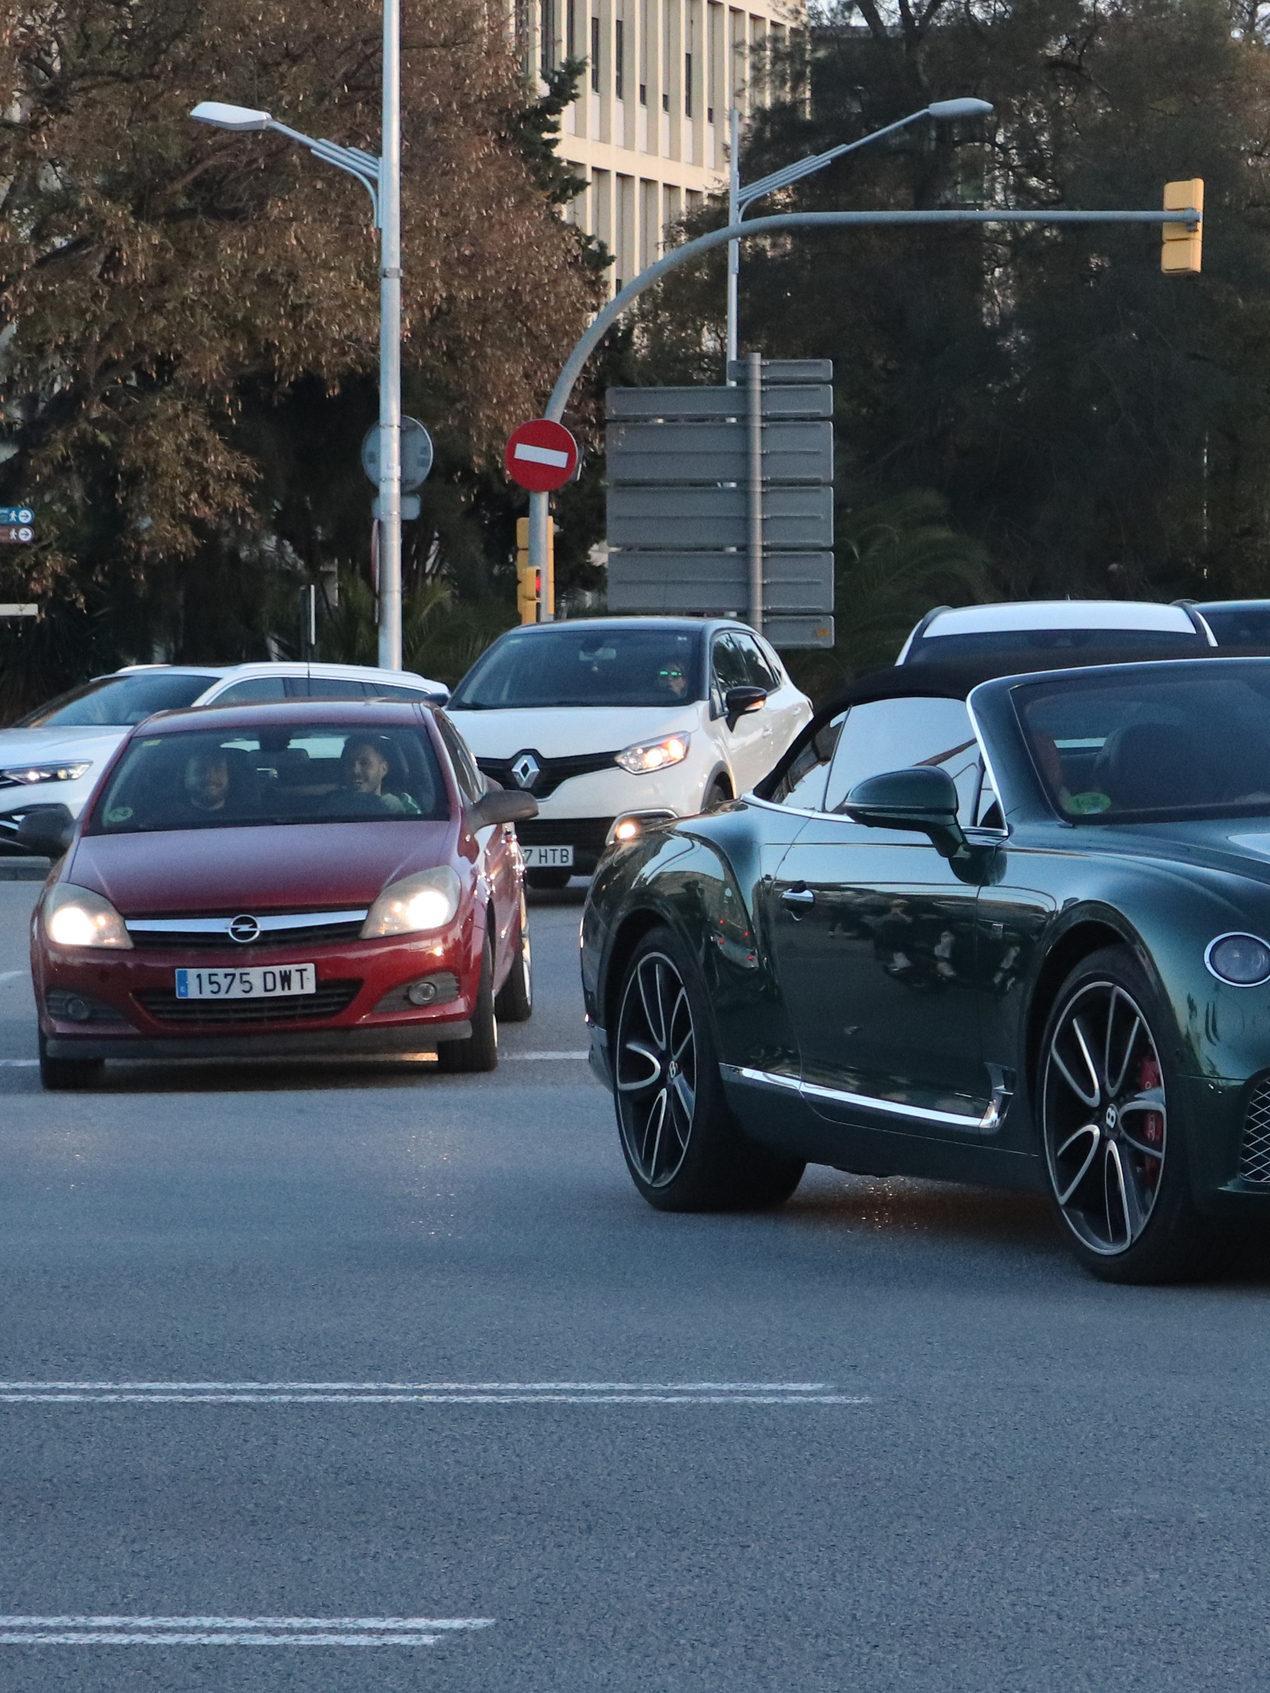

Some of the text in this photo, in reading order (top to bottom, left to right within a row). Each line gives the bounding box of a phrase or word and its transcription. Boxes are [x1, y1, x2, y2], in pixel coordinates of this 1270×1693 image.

[538, 848, 570, 864] HTB
[195, 972, 253, 995] 1575
[263, 968, 308, 993] DWT
